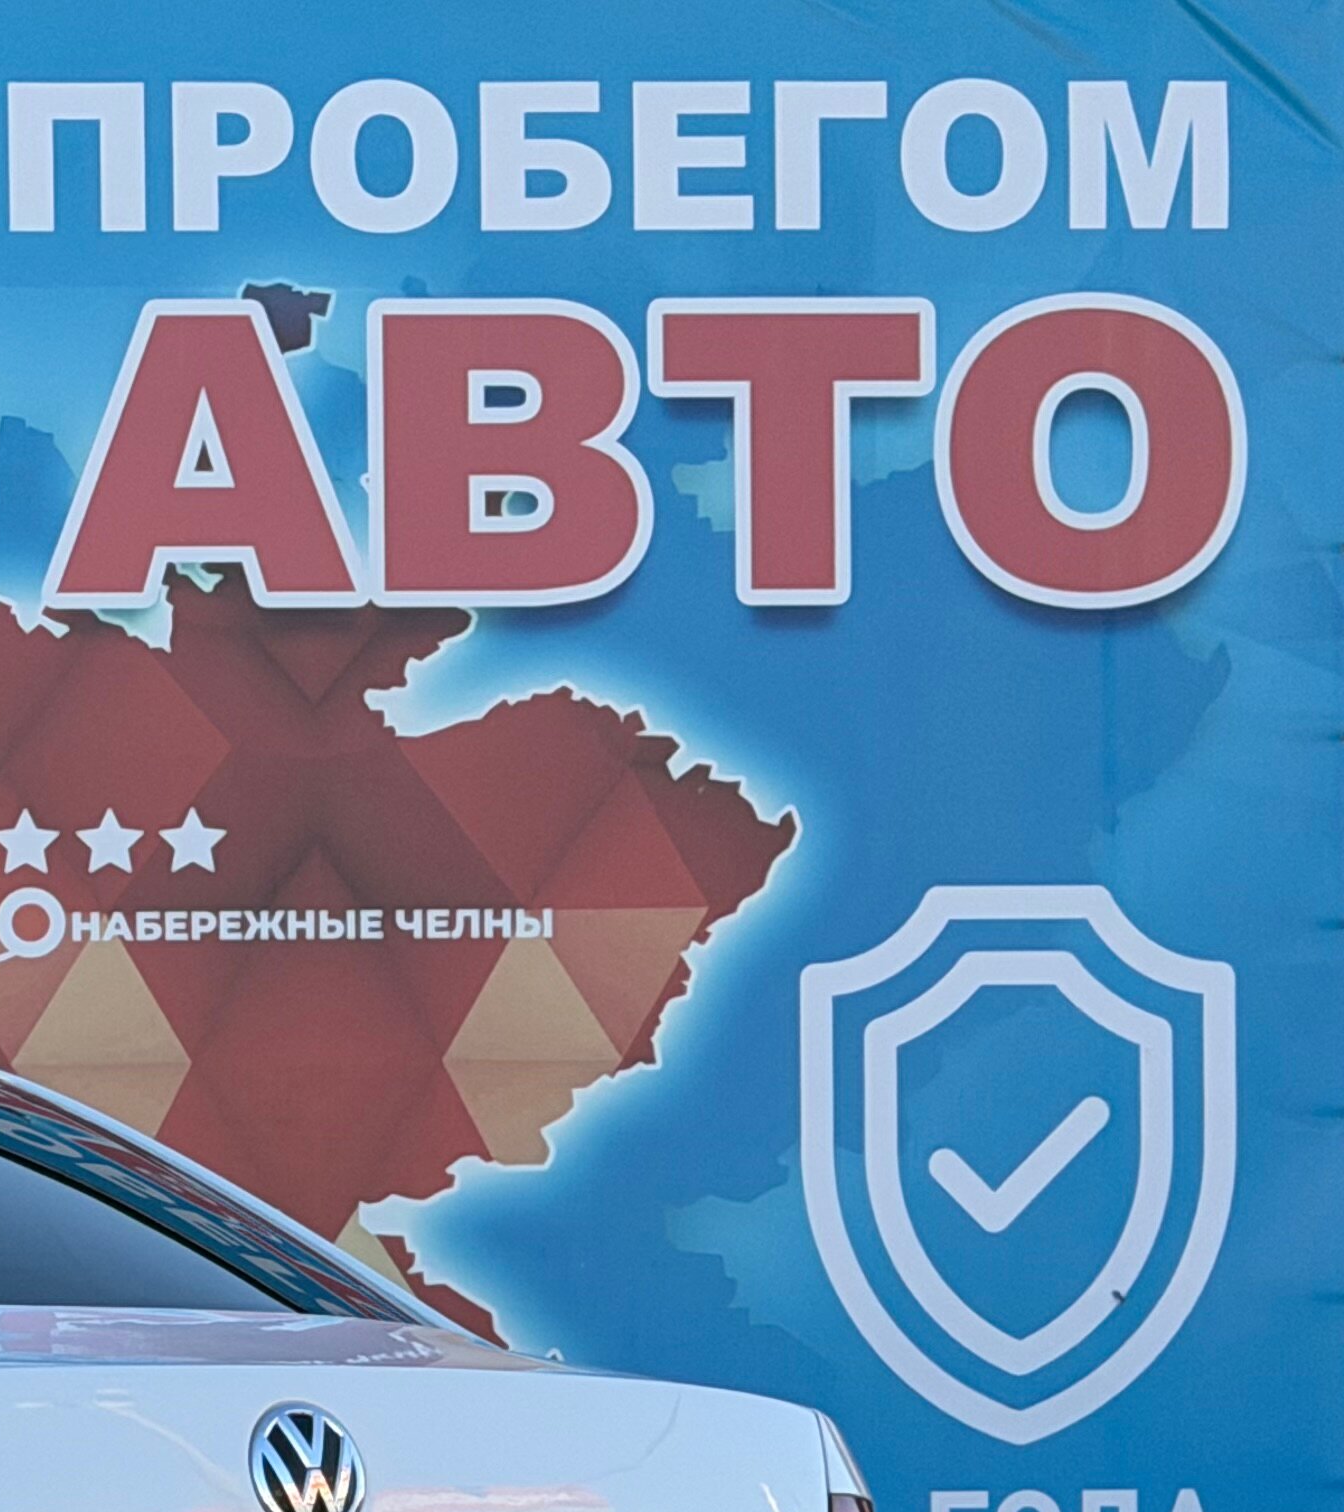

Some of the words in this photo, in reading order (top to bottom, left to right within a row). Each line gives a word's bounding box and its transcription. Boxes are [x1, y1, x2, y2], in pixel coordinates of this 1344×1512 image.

[7, 77, 1230, 234] ПРОБЕГОМ
[42, 291, 1248, 610] АВТО
[71, 909, 385, 942] НАБЕРЕЖНЫЕ
[395, 907, 554, 940] ЧЕЛНЫ
